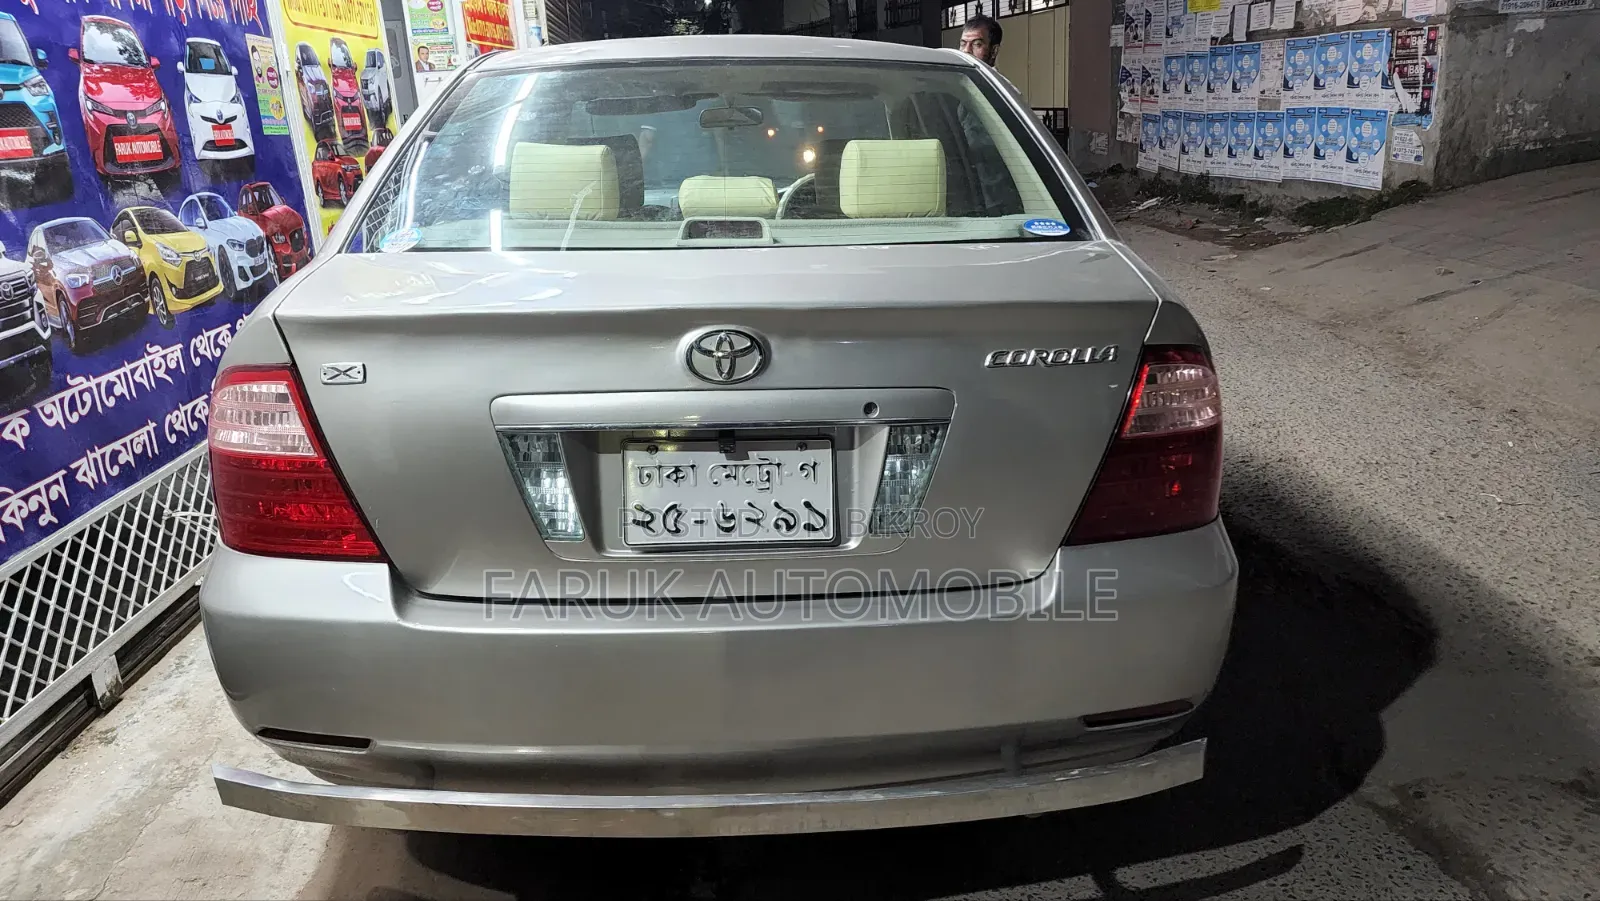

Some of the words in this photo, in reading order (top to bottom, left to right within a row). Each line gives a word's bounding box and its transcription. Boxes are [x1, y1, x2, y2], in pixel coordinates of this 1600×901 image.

[114, 142, 133, 155] FARUK
[132, 140, 162, 154] AUTOMOBILE
[984, 344, 1119, 368] COROLLA
[34, 343, 190, 430] অটোমোবাইল
[70, 419, 159, 490] ঝামেলা
[634, 460, 699, 488] ঢাকা
